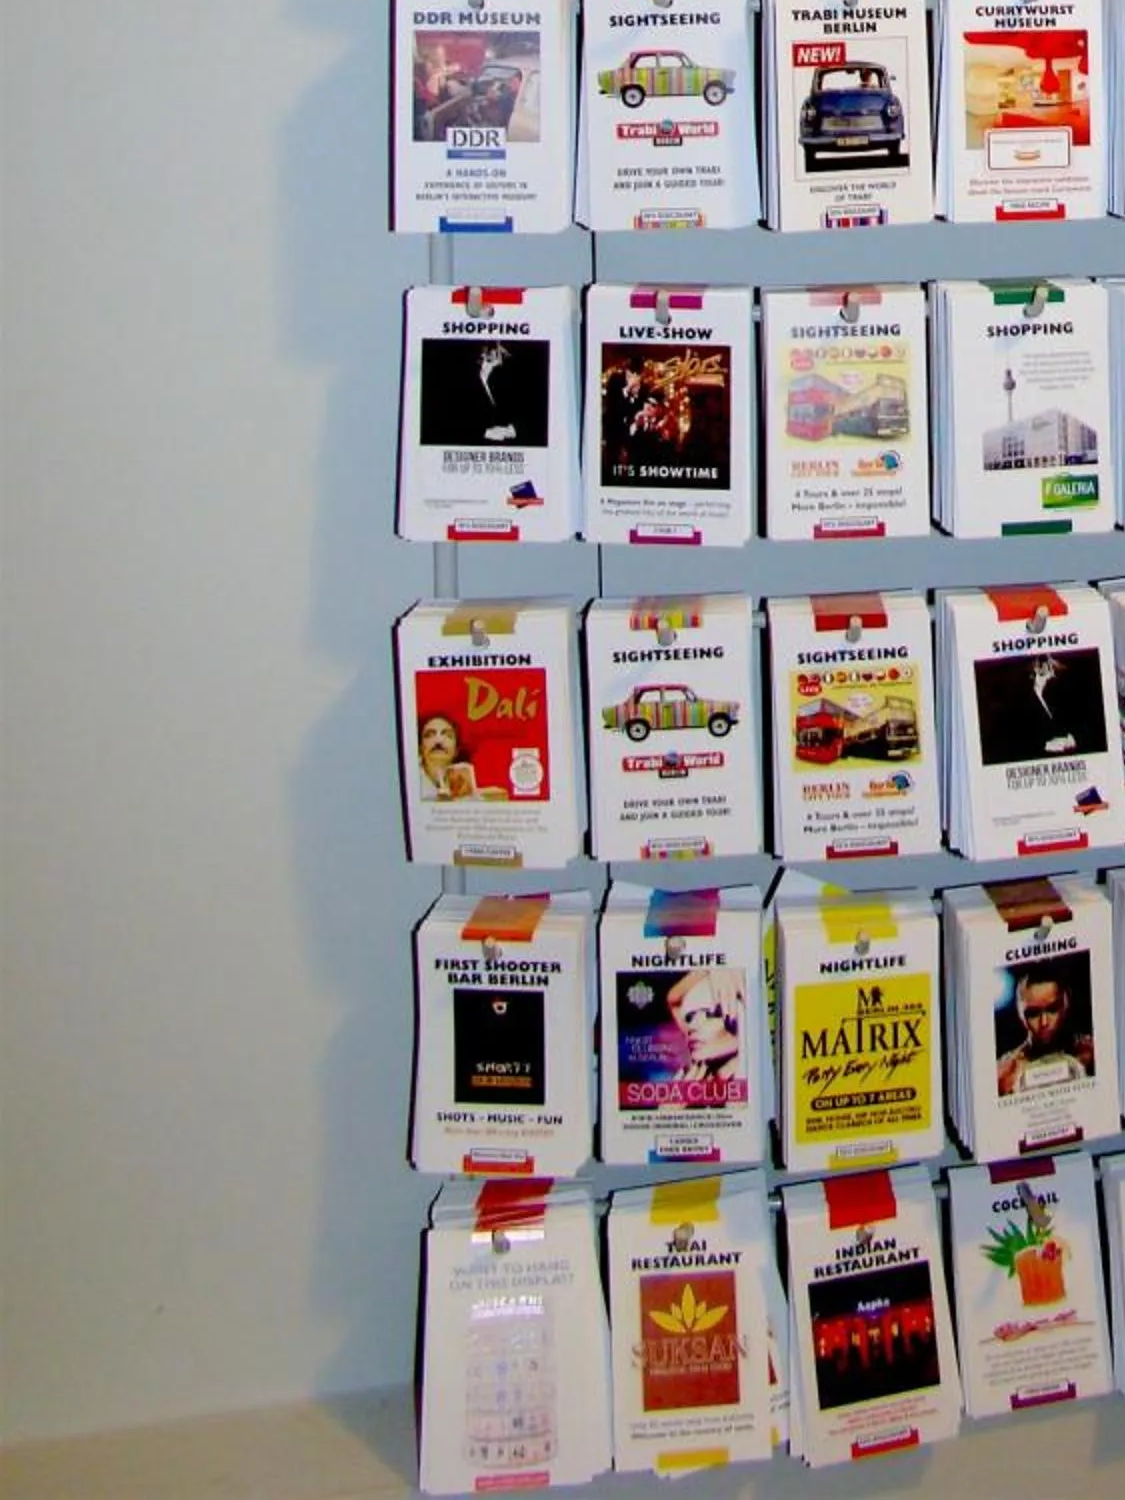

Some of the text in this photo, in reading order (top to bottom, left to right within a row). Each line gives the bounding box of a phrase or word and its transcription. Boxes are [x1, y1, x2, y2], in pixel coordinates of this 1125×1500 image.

[792, 7, 907, 22] TRABI MUSEUM
[975, 4, 1075, 17] CURRYWURST
[413, 12, 541, 25] DDR MUSEUM
[609, 12, 721, 27] SIGHTSEEING
[994, 17, 1057, 29] MUSEUM
[823, 22, 877, 34] BERLIN
[797, 46, 843, 63] NEW!
[452, 129, 501, 147] DDR
[442, 322, 530, 335] SHOPPING
[619, 327, 713, 340] LIVE-SHOW
[791, 324, 901, 339] SIGHTSEEING
[987, 322, 1074, 338] SHOPPING
[639, 465, 719, 479] SHOWTIME
[992, 633, 1079, 653] SHOPPING
[427, 654, 532, 667] EXHIBITION
[612, 647, 725, 663] SIGHTSEEING
[797, 646, 909, 664] SIGHTSEEING
[1005, 937, 1077, 961] CLUBBING
[435, 959, 562, 974] FIRST SHOOTER
[631, 953, 726, 968] NIGHTLIFE
[819, 955, 907, 974] NIGHTLIFE
[447, 973, 549, 987] BAR BERLIN
[801, 1017, 923, 1059] MATRIX
[626, 1081, 742, 1102] SODA CLUB
[536, 1114, 563, 1125] FUN
[665, 1239, 707, 1253] TAI
[835, 1238, 897, 1260] INDIAN
[631, 1252, 742, 1270] RESTAURANT
[814, 1248, 921, 1279] RESTAURANT
